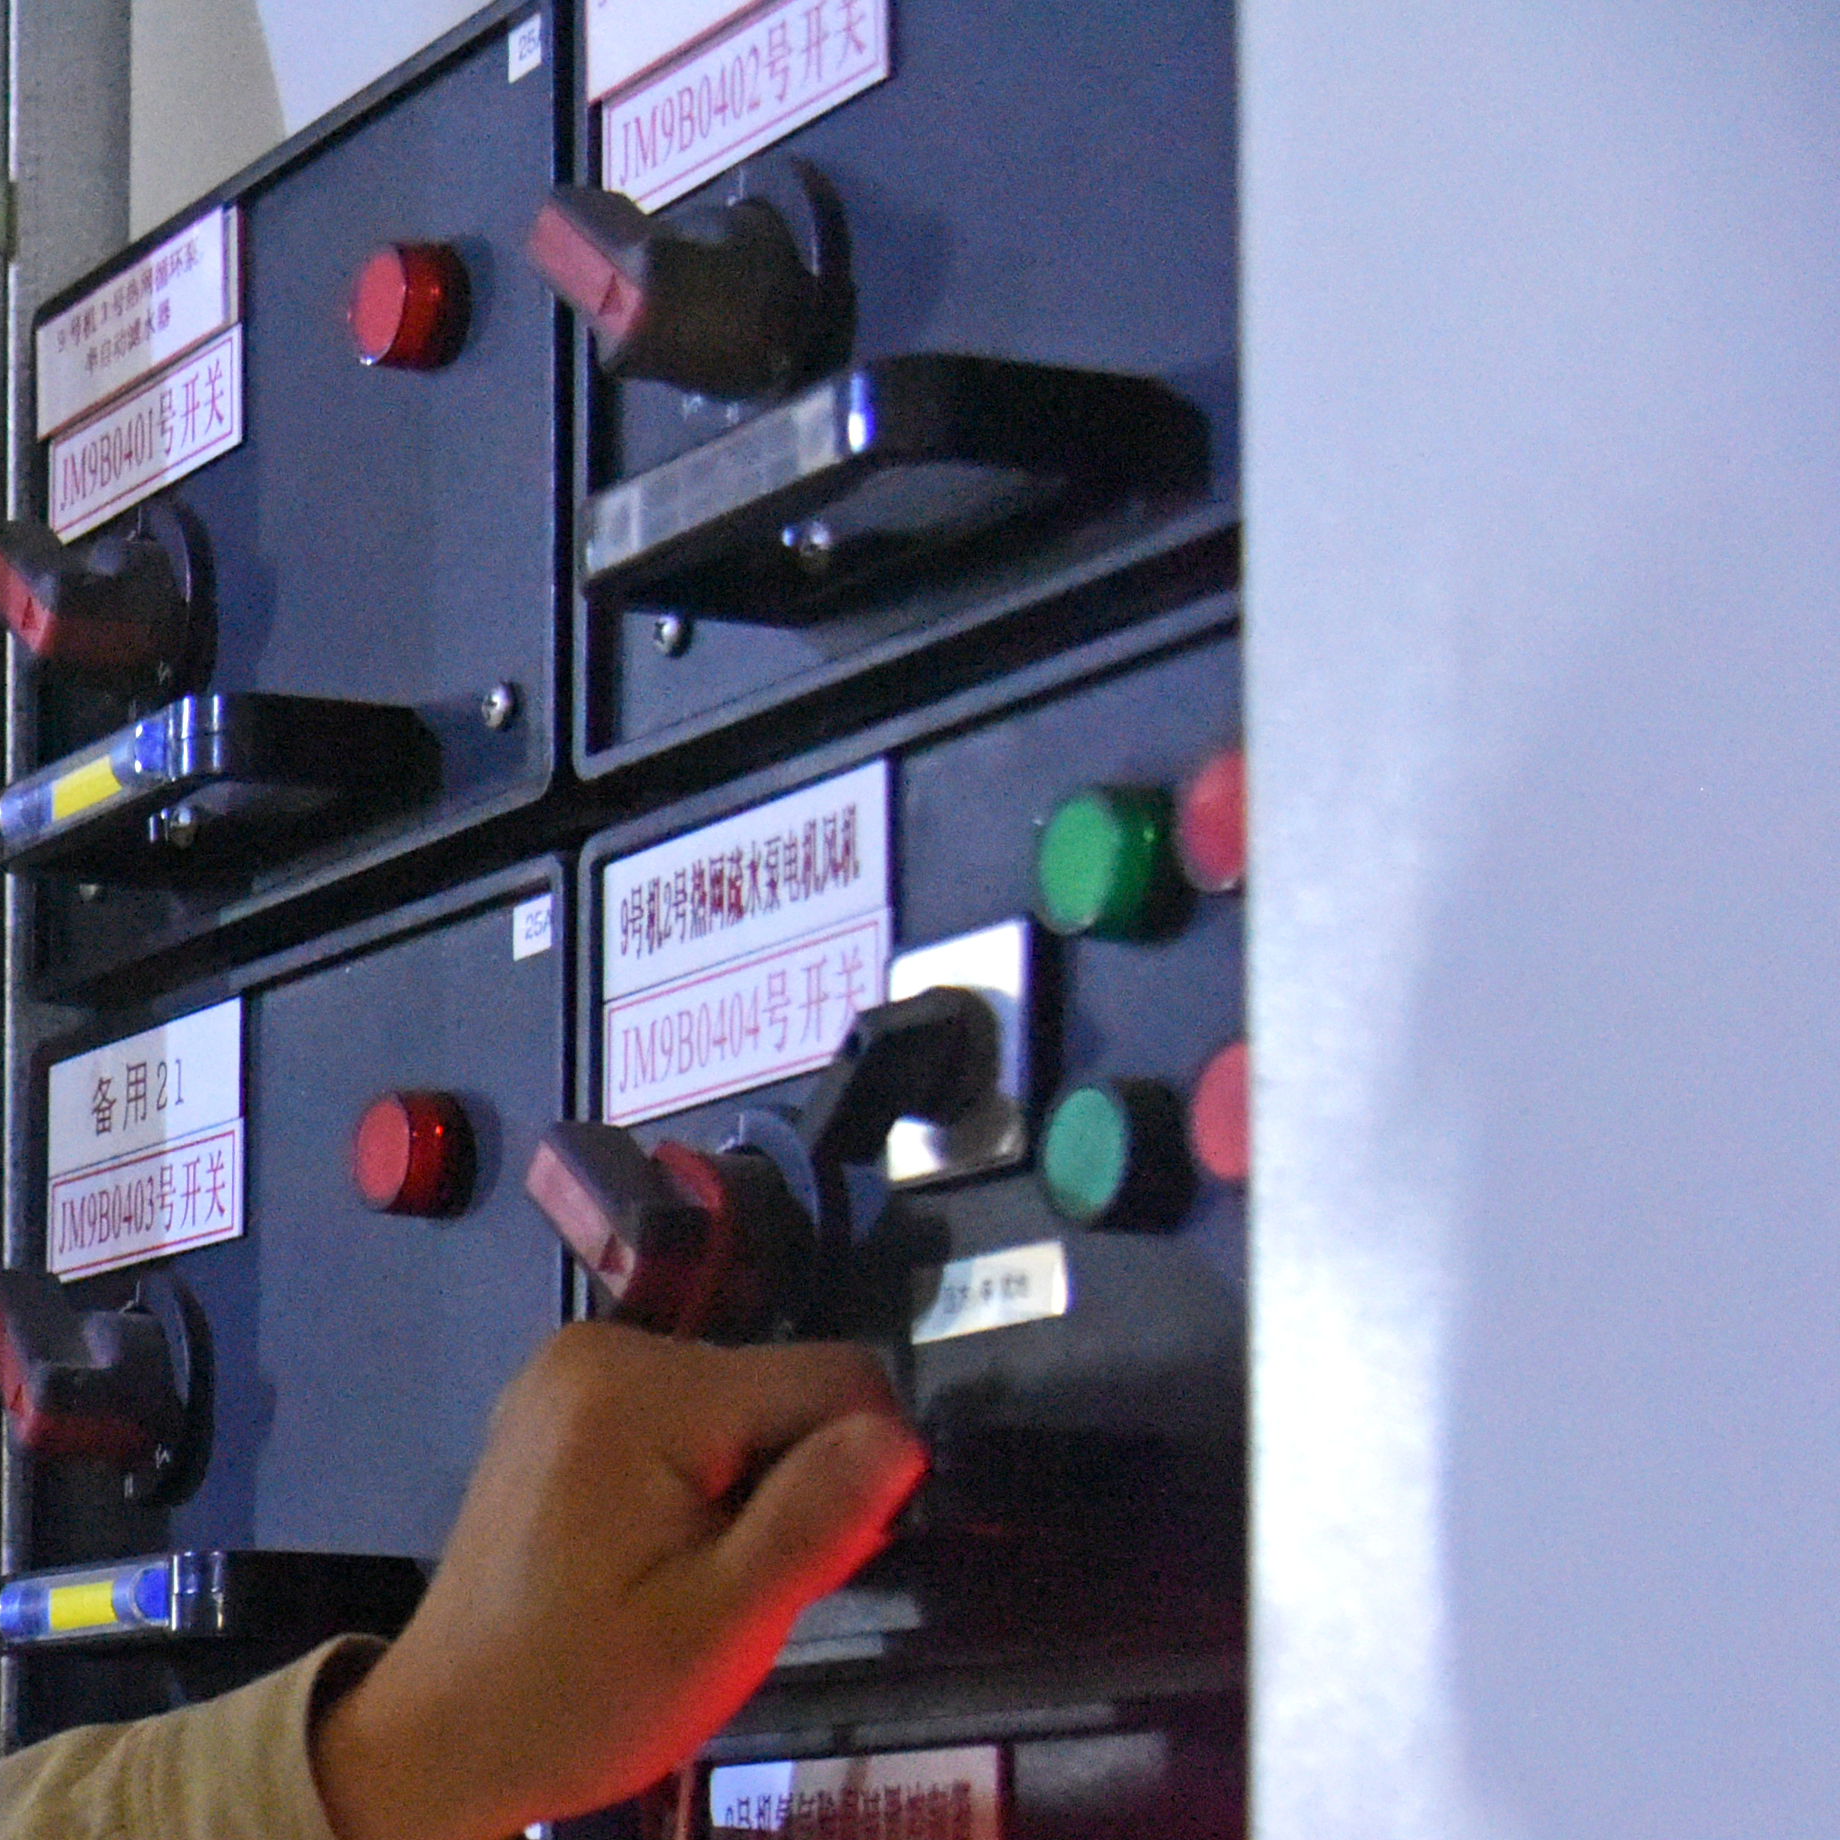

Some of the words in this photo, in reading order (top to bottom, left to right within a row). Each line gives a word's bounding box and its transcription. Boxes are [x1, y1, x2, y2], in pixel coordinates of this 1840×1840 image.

[60, 359, 224, 511] JM9B0401号开关
[90, 1058, 184, 1138] 备用21
[58, 1149, 226, 1254] JM9B0403号开关
